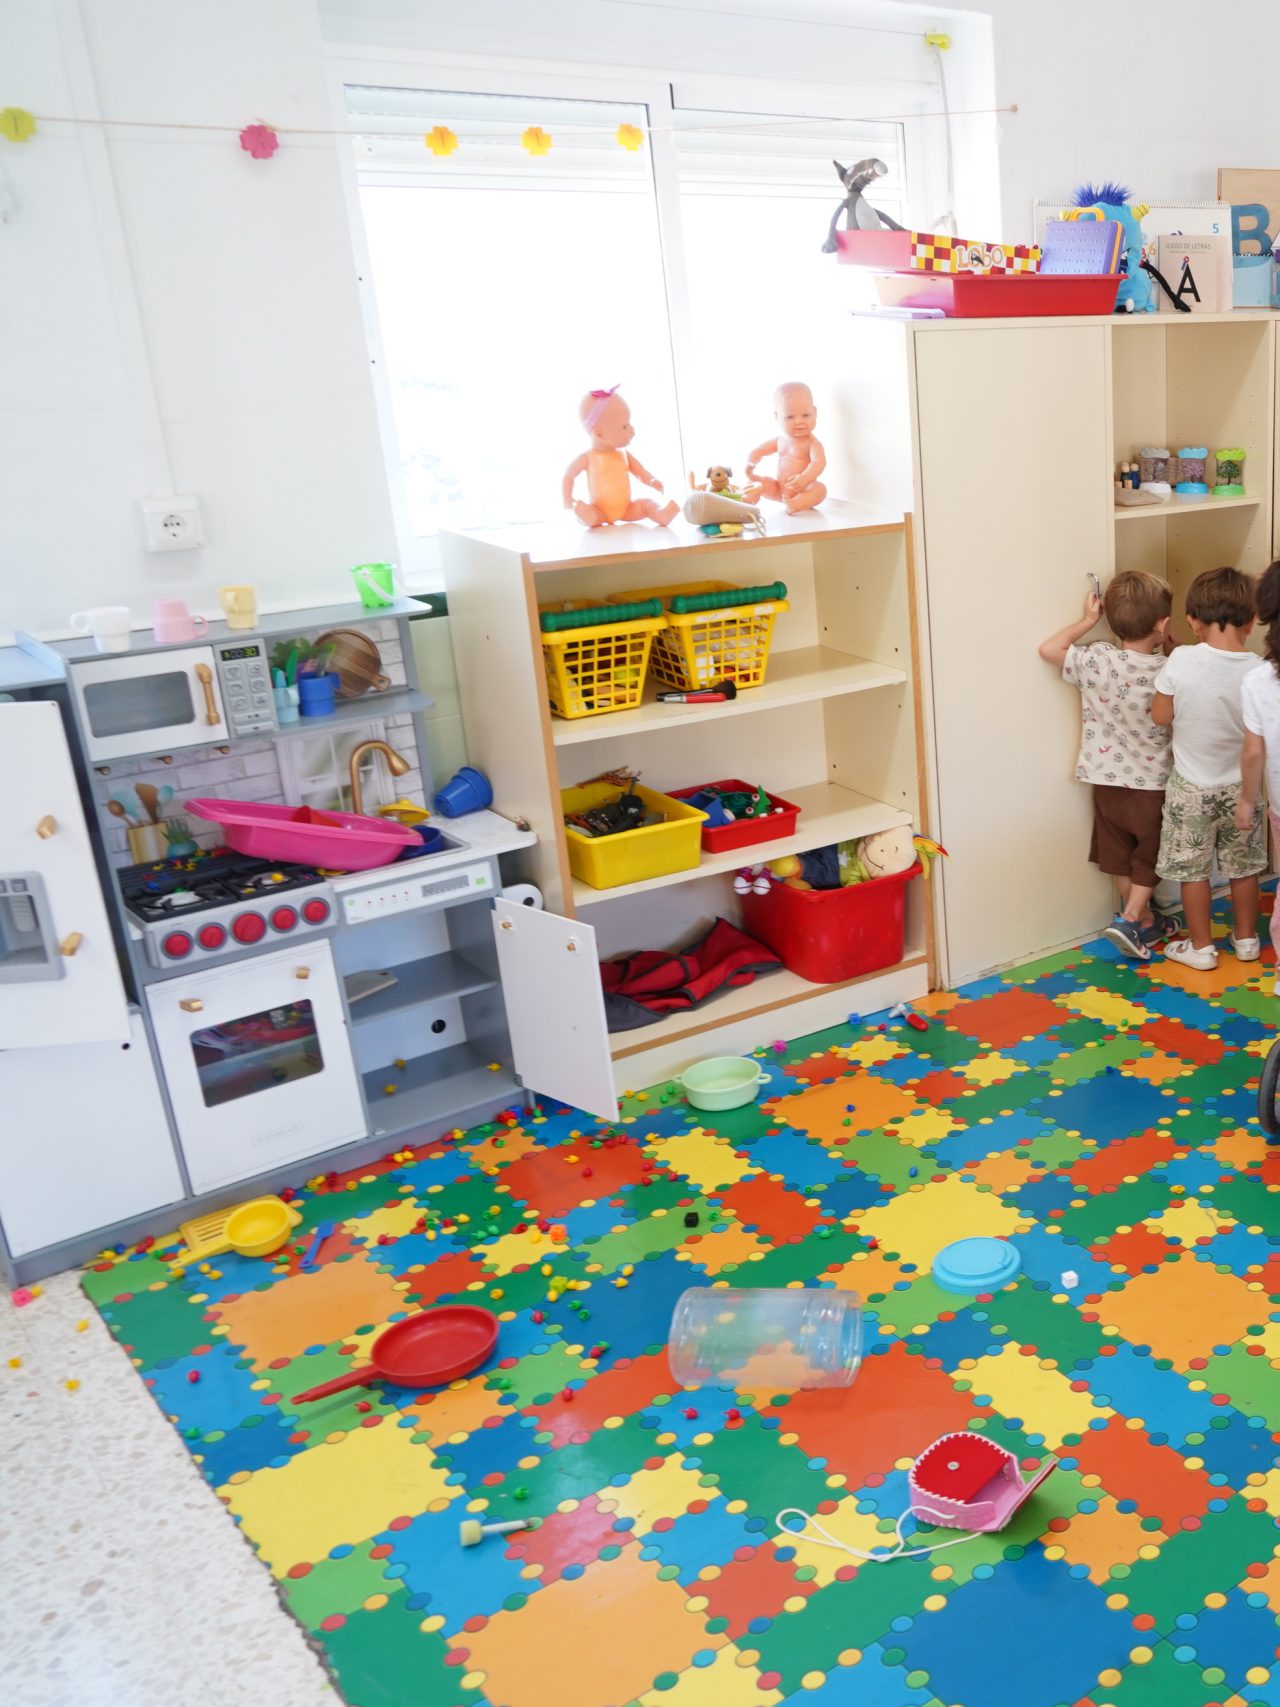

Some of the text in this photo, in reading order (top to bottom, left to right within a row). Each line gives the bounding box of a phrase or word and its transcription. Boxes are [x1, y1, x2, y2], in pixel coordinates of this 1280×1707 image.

[1212, 223, 1219, 234] 5
[1231, 204, 1274, 260] B
[1177, 263, 1201, 302] A
